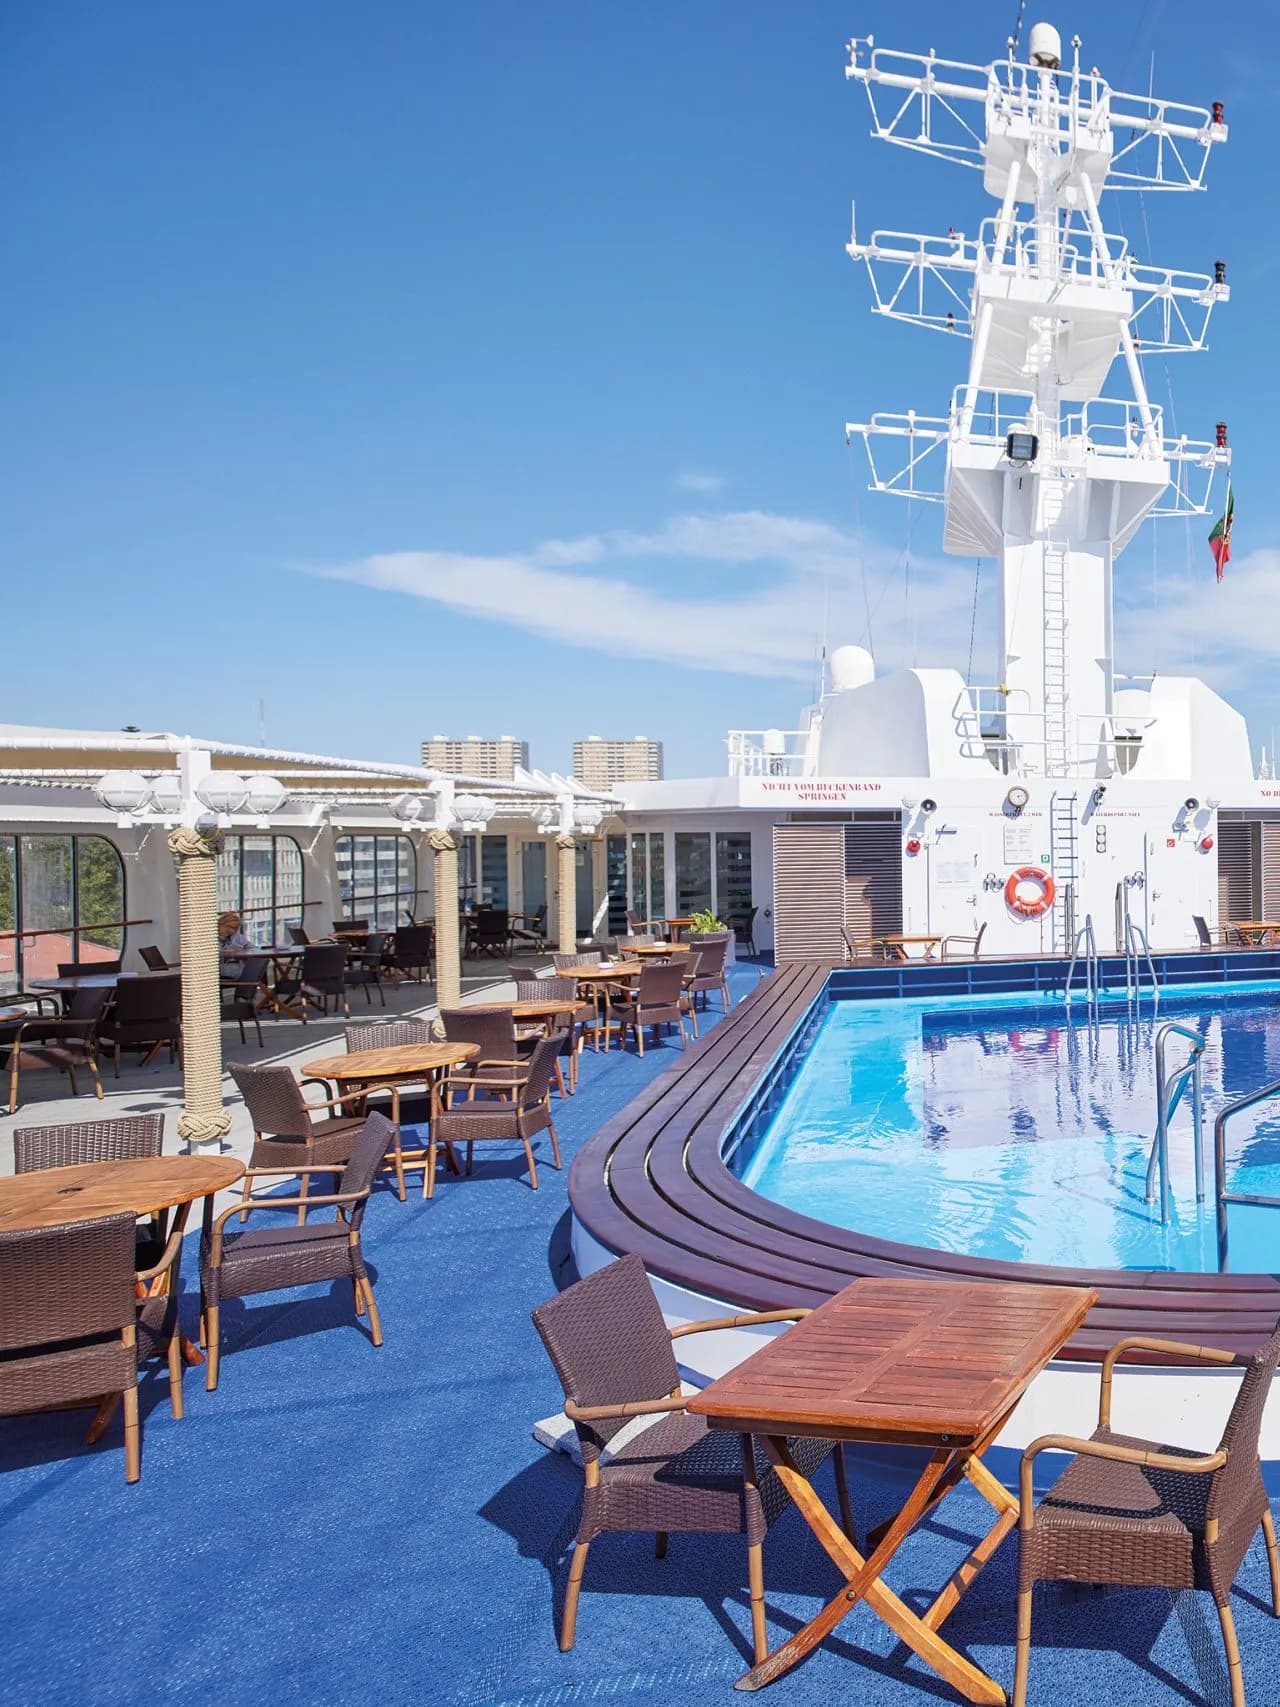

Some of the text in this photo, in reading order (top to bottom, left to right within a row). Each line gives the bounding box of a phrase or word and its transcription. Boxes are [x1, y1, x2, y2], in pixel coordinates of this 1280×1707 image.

[761, 783, 881, 791] NICHT VOM BECKENRAND
[798, 792, 847, 800] SPRINGEN
